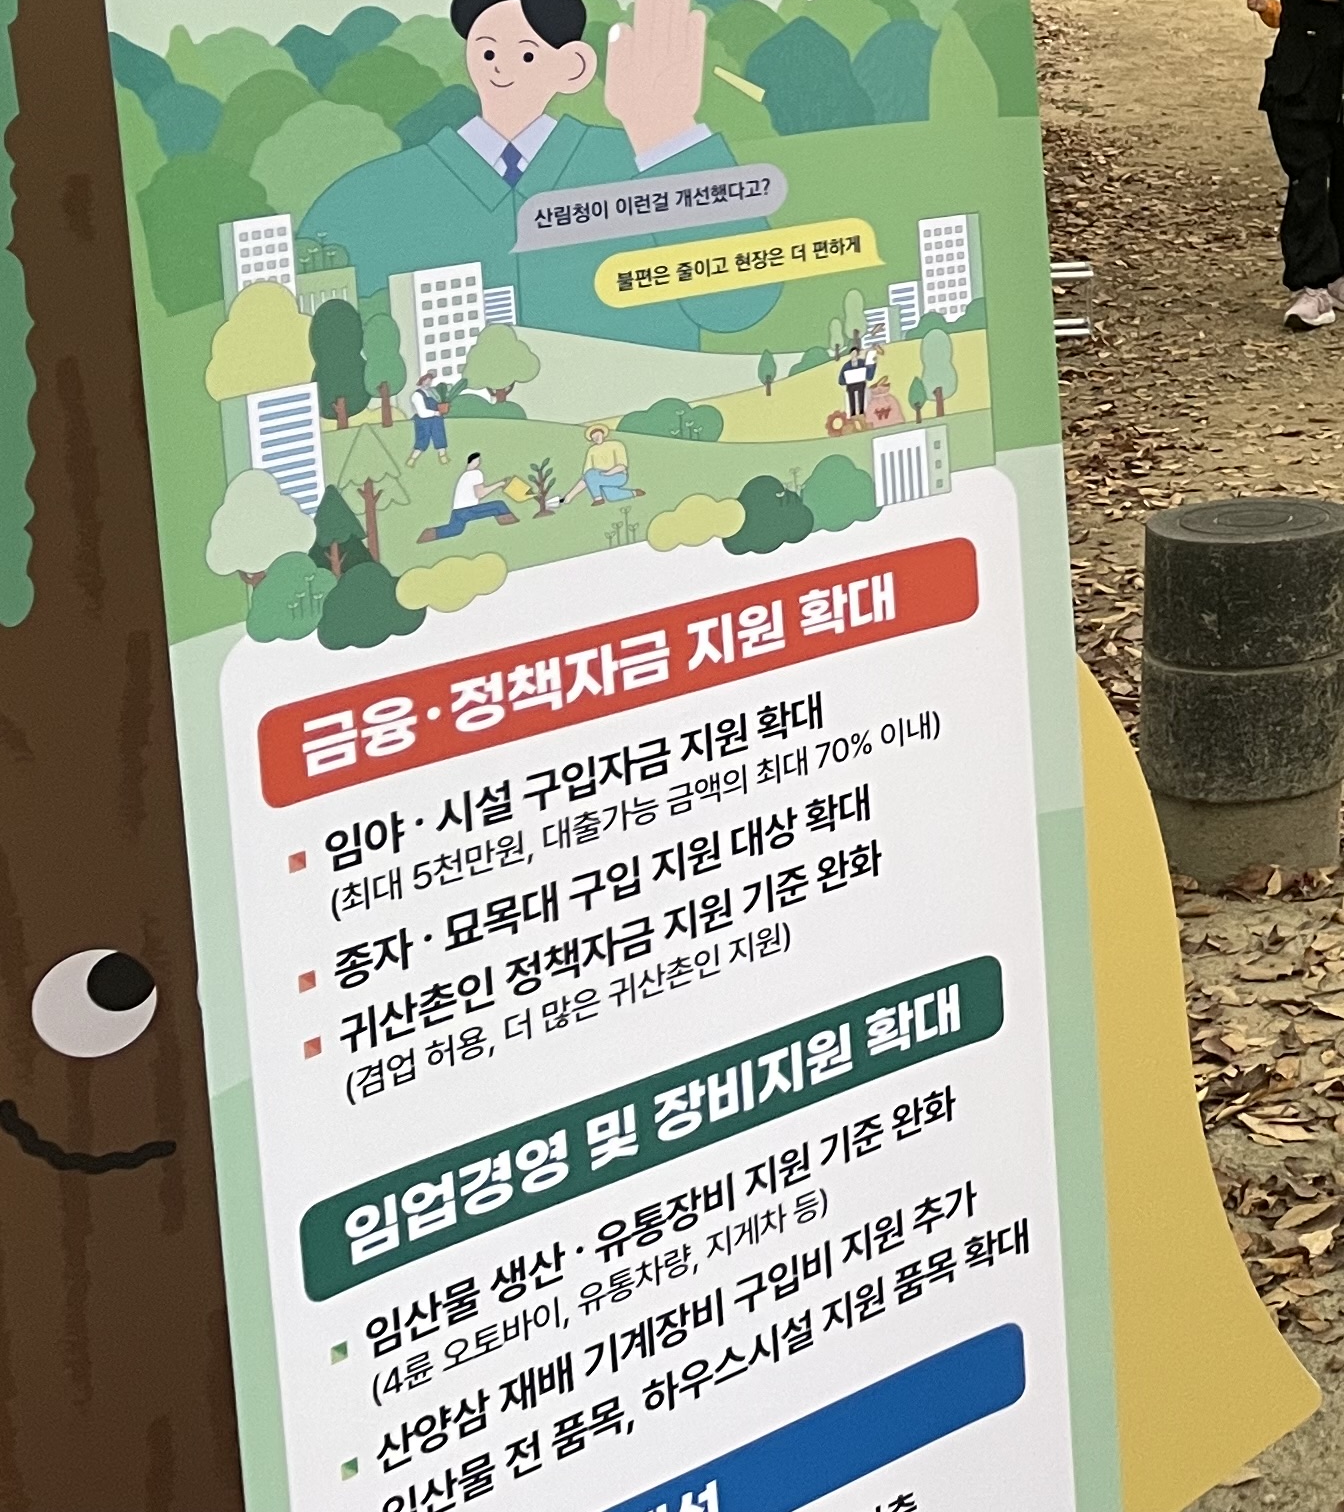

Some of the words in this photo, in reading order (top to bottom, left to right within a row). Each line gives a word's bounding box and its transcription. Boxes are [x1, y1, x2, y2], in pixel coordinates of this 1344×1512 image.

[534, 199, 609, 230] 산림청이
[615, 192, 670, 217] 이런걸
[675, 178, 772, 211] 개선했다고?
[615, 265, 671, 292] 불편은
[675, 257, 729, 283] 줄이고
[734, 250, 786, 273] 현장은
[791, 243, 807, 263] 더
[812, 235, 862, 260] 편하게
[687, 608, 786, 672] 지원
[800, 572, 897, 636] 확대
[330, 864, 403, 922] (최대
[411, 830, 536, 890] 5천만원,
[542, 793, 659, 851] 대출가능
[667, 767, 749, 816] 금액의
[756, 744, 808, 788] 최대
[814, 730, 874, 771] 70%
[881, 709, 943, 749] 이내)
[522, 734, 671, 807] 구입자금
[681, 711, 749, 772] 지원
[756, 690, 824, 739] 확대
[569, 856, 642, 906] 구입
[651, 832, 722, 889] 지원
[730, 804, 798, 861] 대상
[804, 782, 873, 836] 확대
[339, 967, 496, 1056] 귀산촌인
[505, 918, 655, 998] 정책자금
[664, 889, 734, 945] 지원
[742, 864, 808, 917] 기준
[816, 839, 883, 893] 완화
[345, 1054, 419, 1106] (겸업
[424, 1026, 496, 1068] 허용,
[504, 1009, 534, 1043] 더
[541, 985, 601, 1036] 많은
[607, 948, 722, 1009] 귀산촌인
[728, 920, 791, 968] 지원)
[342, 1134, 571, 1266] 임업경영
[587, 1106, 640, 1171] 및
[653, 1022, 852, 1141] 장비지원
[866, 983, 961, 1053] 확대
[364, 1278, 481, 1358] 임산물
[744, 1143, 812, 1199] 지원
[819, 1115, 884, 1167] 기준
[891, 1085, 957, 1139] 완화
[371, 1353, 434, 1406] (4륜
[442, 1299, 570, 1374] 오토바이,
[577, 1243, 700, 1315] 유통차량,
[705, 1207, 788, 1259] 지게차
[792, 1187, 830, 1228] 등)
[376, 1389, 490, 1473] 산양삼
[500, 1350, 575, 1412] 재배
[583, 1284, 727, 1375] 기계장비
[734, 1249, 835, 1318] 구입비
[840, 1213, 906, 1266] 지원
[911, 1181, 979, 1237] 추가
[505, 1429, 543, 1479] 전
[551, 1396, 635, 1461] 품목,
[640, 1309, 816, 1414] 하우스시설
[820, 1276, 887, 1334] 지원
[892, 1244, 958, 1304] 품목
[962, 1218, 1031, 1275] 확대
